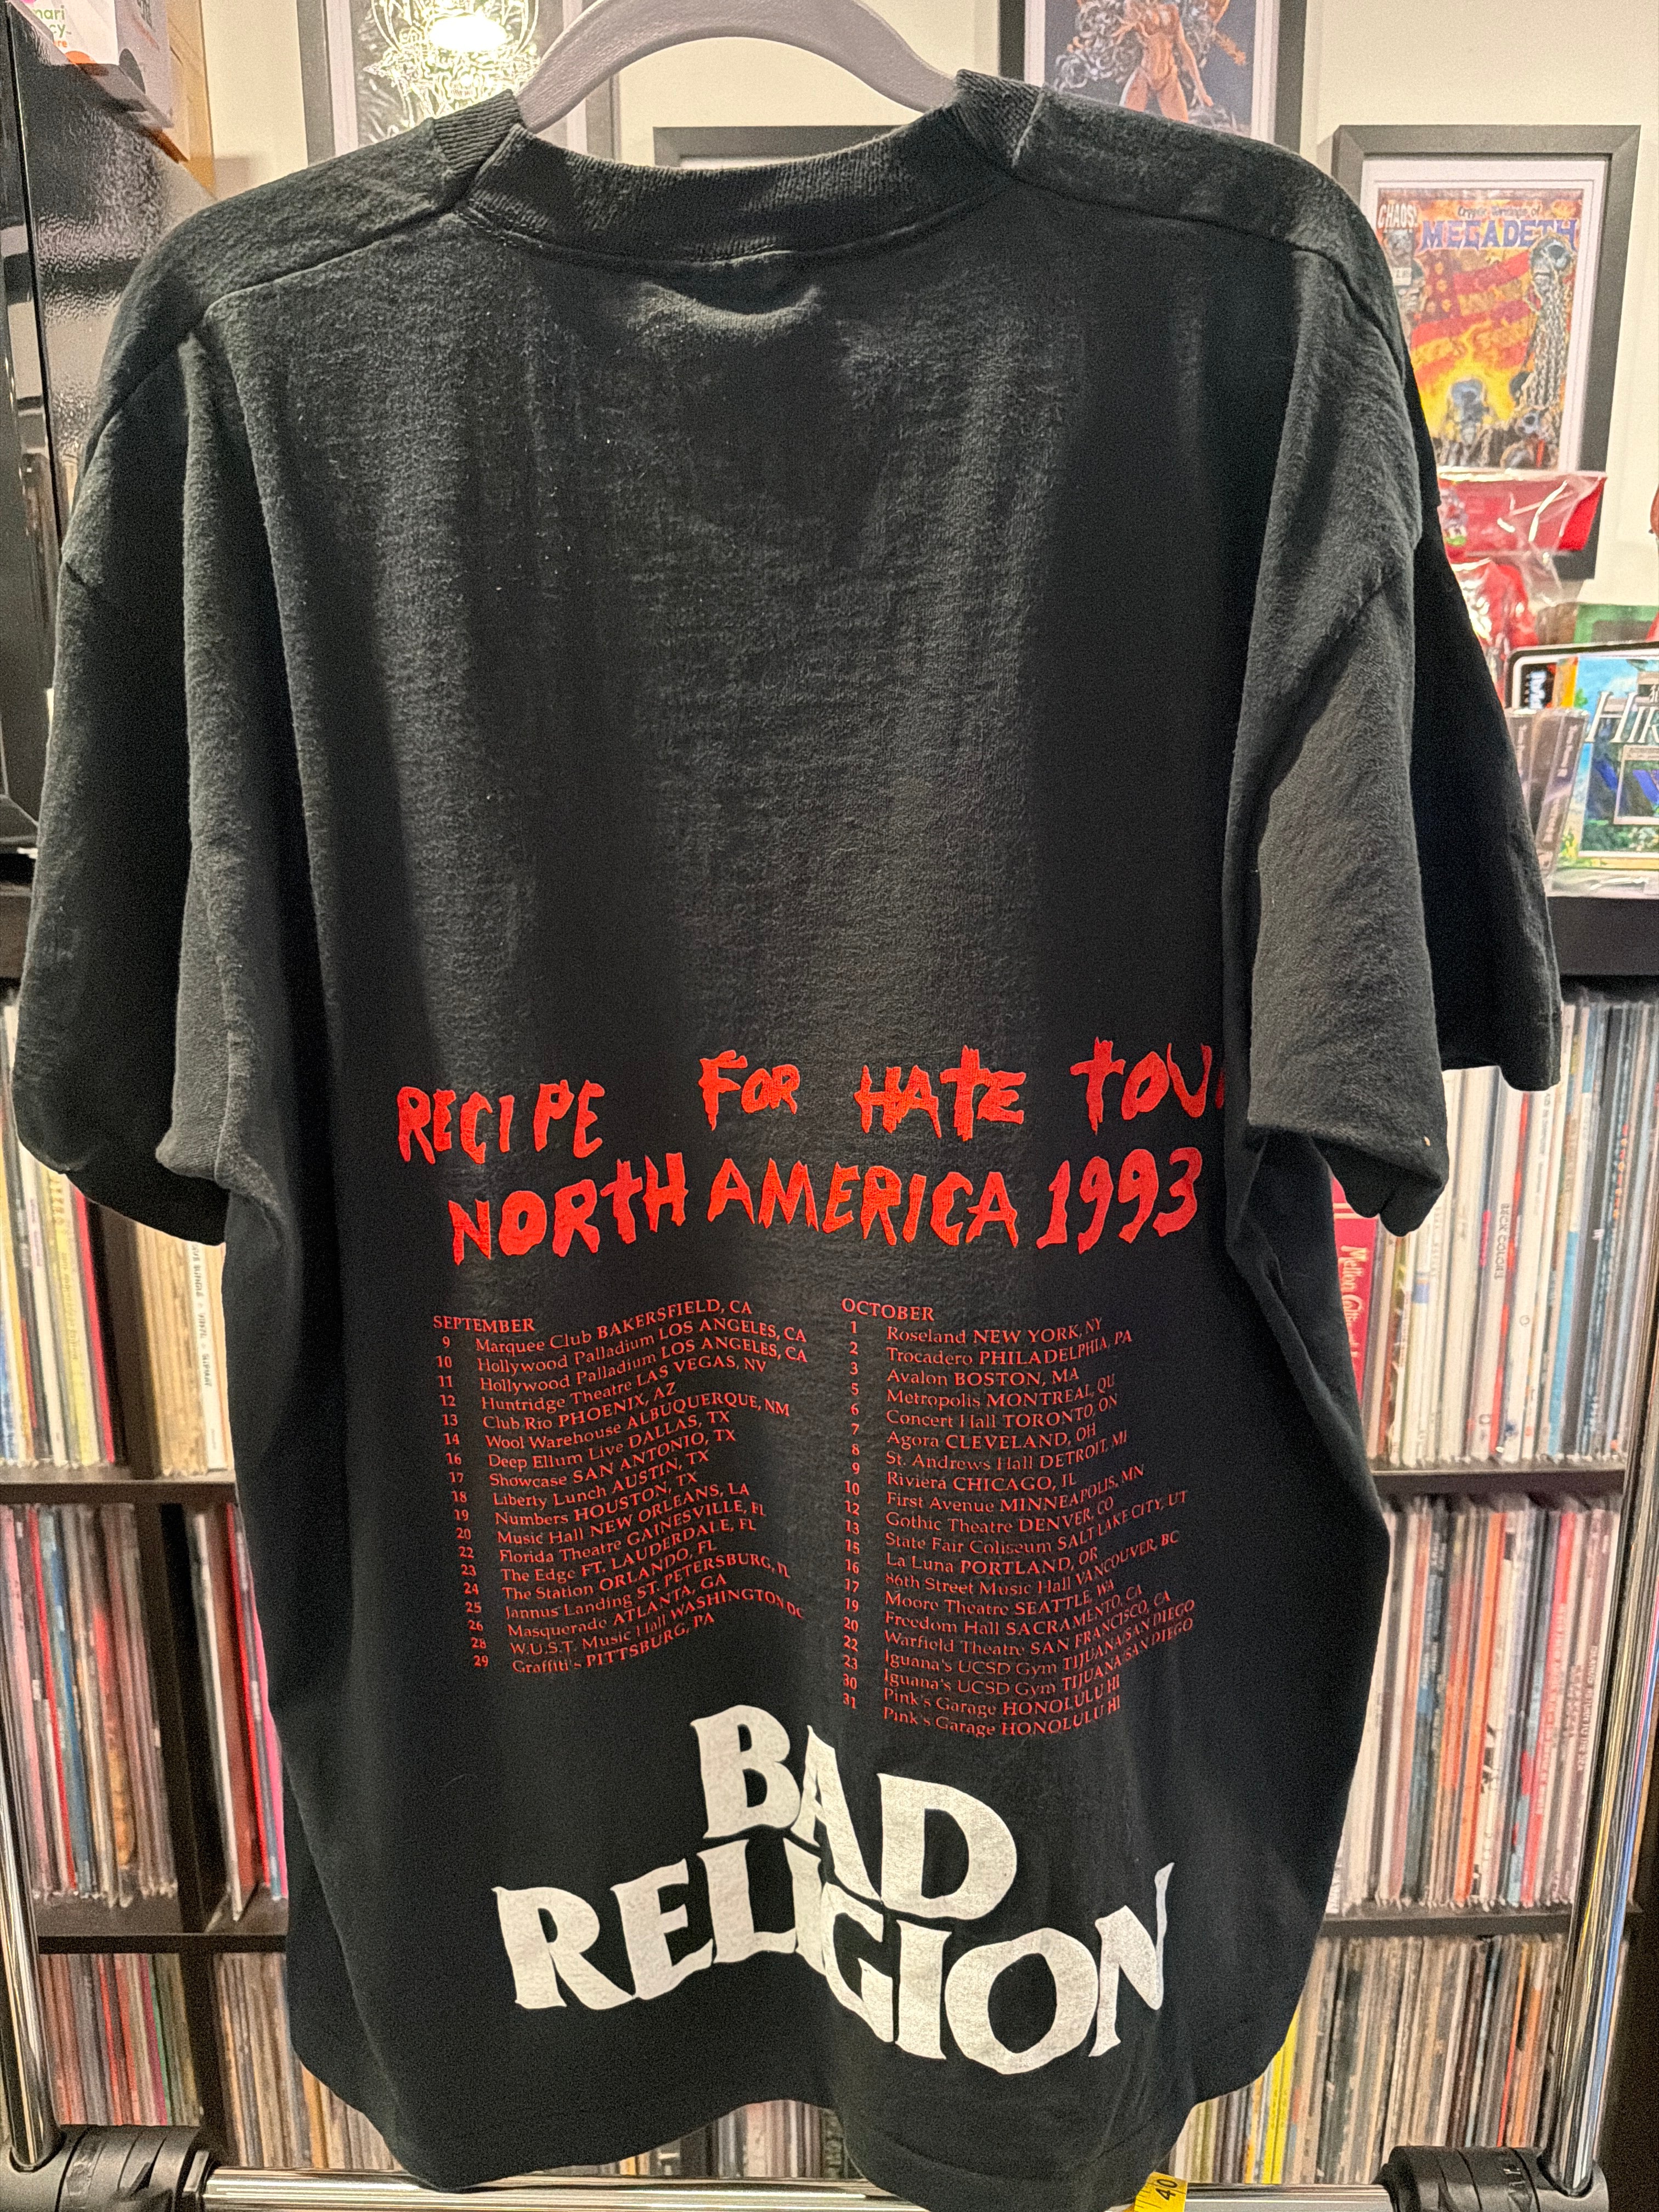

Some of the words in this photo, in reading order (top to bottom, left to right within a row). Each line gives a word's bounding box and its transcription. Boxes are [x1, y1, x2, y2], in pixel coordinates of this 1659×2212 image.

[1419, 218, 1579, 251] MEGADETH
[396, 1080, 605, 1165] RECIPE
[698, 1050, 800, 1130] FOR
[853, 1046, 1026, 1142] HATE
[1069, 1037, 1224, 1133] TOU
[448, 1153, 688, 1266] NORTH
[707, 1159, 1018, 1247] AMERICA
[1036, 1148, 1202, 1254] 1993
[1338, 1245, 1369, 1293] Mellon
[433, 1316, 534, 1333] SEPTEMBER
[475, 1339, 544, 1357] Marquee
[549, 1331, 591, 1349] Club
[597, 1299, 724, 1339] BAKERSFIELD,
[729, 1301, 751, 1314] CA
[842, 1299, 933, 1322] OCTOBER
[437, 1356, 452, 1368] 10
[477, 1355, 567, 1376] Hollywood
[574, 1336, 654, 1365] Palladium
[658, 1321, 692, 1340] LOS
[699, 1318, 780, 1341] ANGELES,
[783, 1327, 806, 1342] CA
[886, 1347, 972, 1365] Trocadero
[1115, 1331, 1131, 1345] PA
[887, 1327, 965, 1344] Roseland
[974, 1330, 1020, 1344] NEW
[439, 1376, 452, 1387] 11
[479, 1375, 569, 1396] Hollywood
[576, 1355, 656, 1385] Palladium
[661, 1339, 694, 1359] LOS
[702, 1337, 781, 1360] ANGELES,
[785, 1347, 807, 1363] CA
[887, 1370, 947, 1386] Avalon
[954, 1373, 1045, 1386] BOSTON,
[1052, 1368, 1078, 1384] MA
[441, 1395, 455, 1407] 12
[482, 1397, 565, 1414] Huntridge
[570, 1381, 631, 1404] Theatre
[636, 1365, 667, 1387] LAS
[673, 1356, 738, 1373] VEGAS,
[744, 1357, 766, 1373] NV
[887, 1390, 980, 1411] Metropolis
[443, 1414, 458, 1426] 13
[483, 1417, 520, 1430] Club
[524, 1417, 552, 1430] Rio
[558, 1394, 648, 1427] PHOENIX,
[654, 1383, 674, 1401] AZ
[445, 1434, 459, 1445] 14
[485, 1436, 523, 1449] Wool
[528, 1424, 620, 1448] Warehouse
[627, 1393, 761, 1430] ALBUQUERQUE,
[764, 1398, 789, 1417] NM
[886, 1410, 952, 1427] Concert
[446, 1453, 461, 1465] 16
[488, 1454, 527, 1472] Deep
[532, 1454, 582, 1469] Ellum
[588, 1444, 623, 1460] Live
[628, 1415, 701, 1448] DALLAS,
[707, 1411, 729, 1424] TX
[887, 1432, 938, 1450] Agora
[1076, 1424, 1095, 1441] OH
[489, 1474, 566, 1488] Showcase
[573, 1463, 613, 1483] SAN
[620, 1433, 708, 1471] ANTONIO,
[714, 1429, 735, 1442] TX
[912, 1454, 990, 1470] Andrews
[452, 1491, 466, 1503] 18
[493, 1493, 546, 1510] Liberty
[553, 1486, 606, 1506] Lunch
[612, 1458, 681, 1493] AUSTIN,
[685, 1450, 708, 1465] TX
[845, 1481, 859, 1496] 10
[887, 1492, 922, 1508] First
[929, 1498, 994, 1513] Avenue
[887, 1472, 946, 1489] Riviera
[952, 1477, 1055, 1492] CHICAGO,
[455, 1510, 468, 1521] 19
[495, 1513, 568, 1525] Numbers
[676, 1474, 696, 1486] TX
[456, 1528, 470, 1540] 20
[497, 1532, 541, 1544] Music
[549, 1528, 583, 1544] Hall
[590, 1515, 631, 1538] NEW
[637, 1485, 723, 1523] ORLEANS,
[729, 1483, 749, 1496] LA
[845, 1500, 859, 1516] 12
[885, 1512, 939, 1531] Gothic
[950, 1519, 1012, 1533] Theatre
[459, 1546, 473, 1559] 22
[500, 1550, 553, 1562] Florida
[559, 1541, 621, 1561] Theatre
[846, 1520, 859, 1534] 13
[885, 1533, 925, 1549] State
[932, 1537, 963, 1552] Fair
[461, 1565, 476, 1576] 23
[501, 1568, 529, 1582] The
[534, 1569, 574, 1584] Edge
[581, 1561, 605, 1577] FT.
[845, 1539, 859, 1554] 15
[887, 1553, 905, 1567] La
[911, 1556, 953, 1573] Luna
[961, 1558, 1073, 1576] PORTLAND,
[1079, 1547, 1097, 1565] OR
[502, 1587, 531, 1600] The
[535, 1586, 593, 1599] Station
[845, 1559, 859, 1574] 16
[924, 1578, 972, 1594] Street
[845, 1579, 859, 1592] 17
[466, 1601, 481, 1613] 25
[564, 1595, 632, 1616] Landing
[636, 1581, 659, 1600] ST.
[468, 1620, 483, 1631] 26
[701, 1574, 726, 1589] GA
[845, 1598, 859, 1612] 19
[964, 1621, 998, 1635] Hall
[844, 1617, 858, 1632] 20
[1031, 1640, 1068, 1654] SAN
[474, 1656, 488, 1667] 29
[843, 1635, 857, 1652] 22
[958, 1661, 1010, 1675] UCSD
[843, 1673, 857, 1690] 30
[844, 1655, 857, 1670] 23
[957, 1680, 1009, 1695] UCSD
[843, 1693, 855, 1709] 31
[691, 1705, 1017, 1920] BAD
[492, 1838, 1175, 2075] RELIGION
[1155, 2179, 1178, 2201] 40
